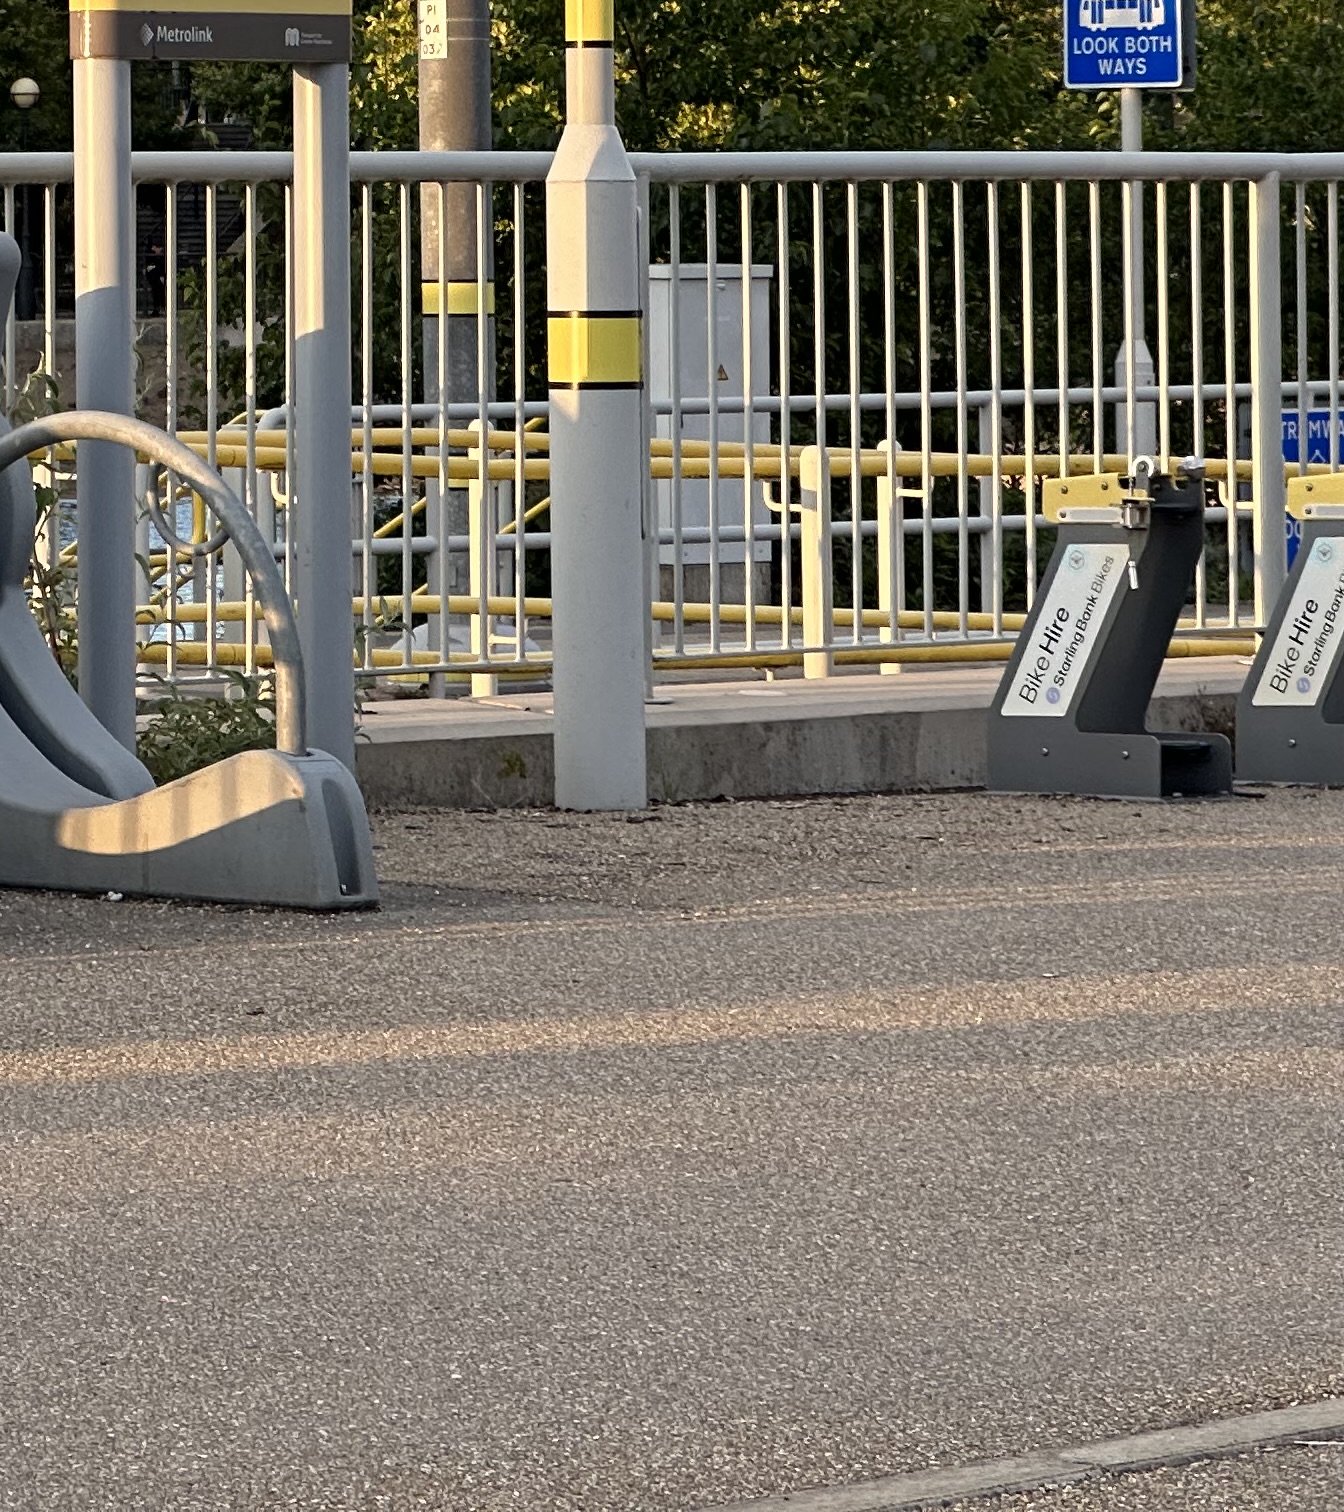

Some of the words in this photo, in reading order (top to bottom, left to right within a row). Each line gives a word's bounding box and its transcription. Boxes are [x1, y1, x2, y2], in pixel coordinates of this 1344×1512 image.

[156, 25, 213, 43] Metrolink
[1073, 36, 1119, 55] LOOK
[1125, 35, 1172, 54] BOTH
[1097, 57, 1147, 76] WAYS
[1019, 656, 1050, 704] Bike
[1038, 607, 1070, 656] Hire
[1053, 630, 1085, 687] Starling
[1075, 596, 1098, 633] Bank
[1091, 556, 1114, 594] Bikes
[1269, 647, 1300, 694] Bike
[1288, 599, 1319, 646] Hire
[1303, 622, 1334, 677] Starling
[1324, 587, 1344, 623] Bank
